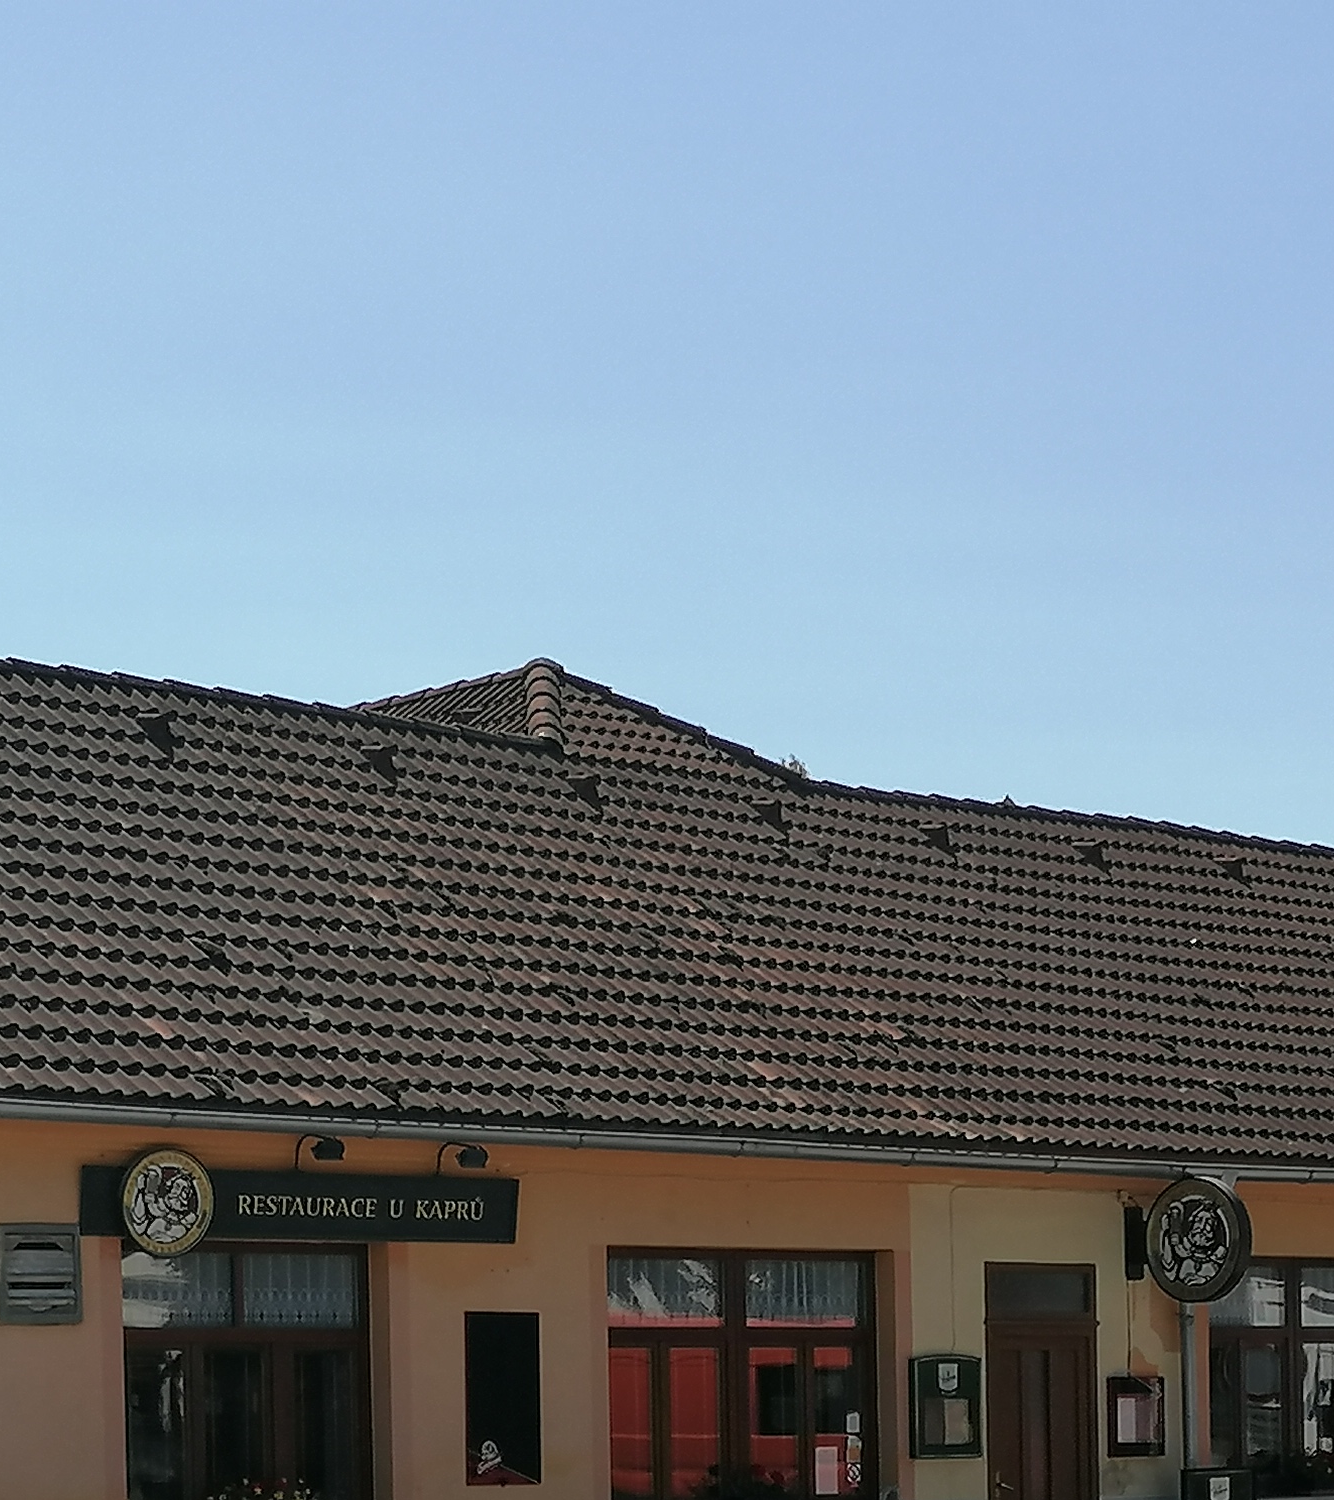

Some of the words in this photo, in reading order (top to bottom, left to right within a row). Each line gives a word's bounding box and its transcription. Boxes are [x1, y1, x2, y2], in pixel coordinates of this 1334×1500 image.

[238, 1195, 377, 1218] RESTAURACE
[390, 1200, 405, 1219] U
[415, 1196, 485, 1221] KAPRŮ
